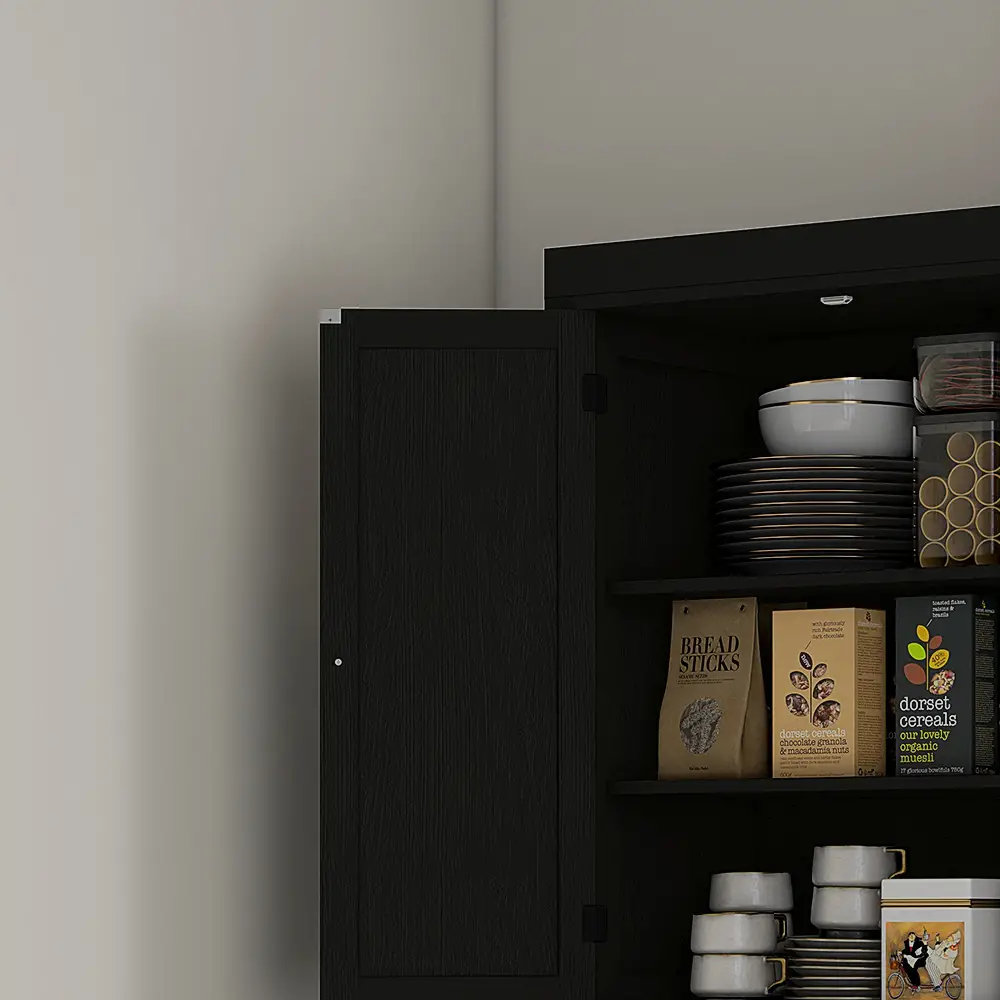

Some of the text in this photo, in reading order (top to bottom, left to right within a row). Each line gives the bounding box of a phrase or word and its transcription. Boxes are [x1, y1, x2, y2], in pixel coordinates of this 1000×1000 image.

[679, 635, 740, 655] BREAD
[679, 653, 740, 674] STICKS
[899, 696, 951, 711] dorset
[899, 712, 957, 728] cereals
[779, 727, 846, 739] dorset cereals
[899, 731, 919, 740] our
[919, 729, 950, 741] lovely
[779, 737, 847, 747] chocolate granola
[899, 741, 939, 753] organic
[779, 746, 850, 755] & macadamia nuts
[899, 752, 935, 763] muesli
